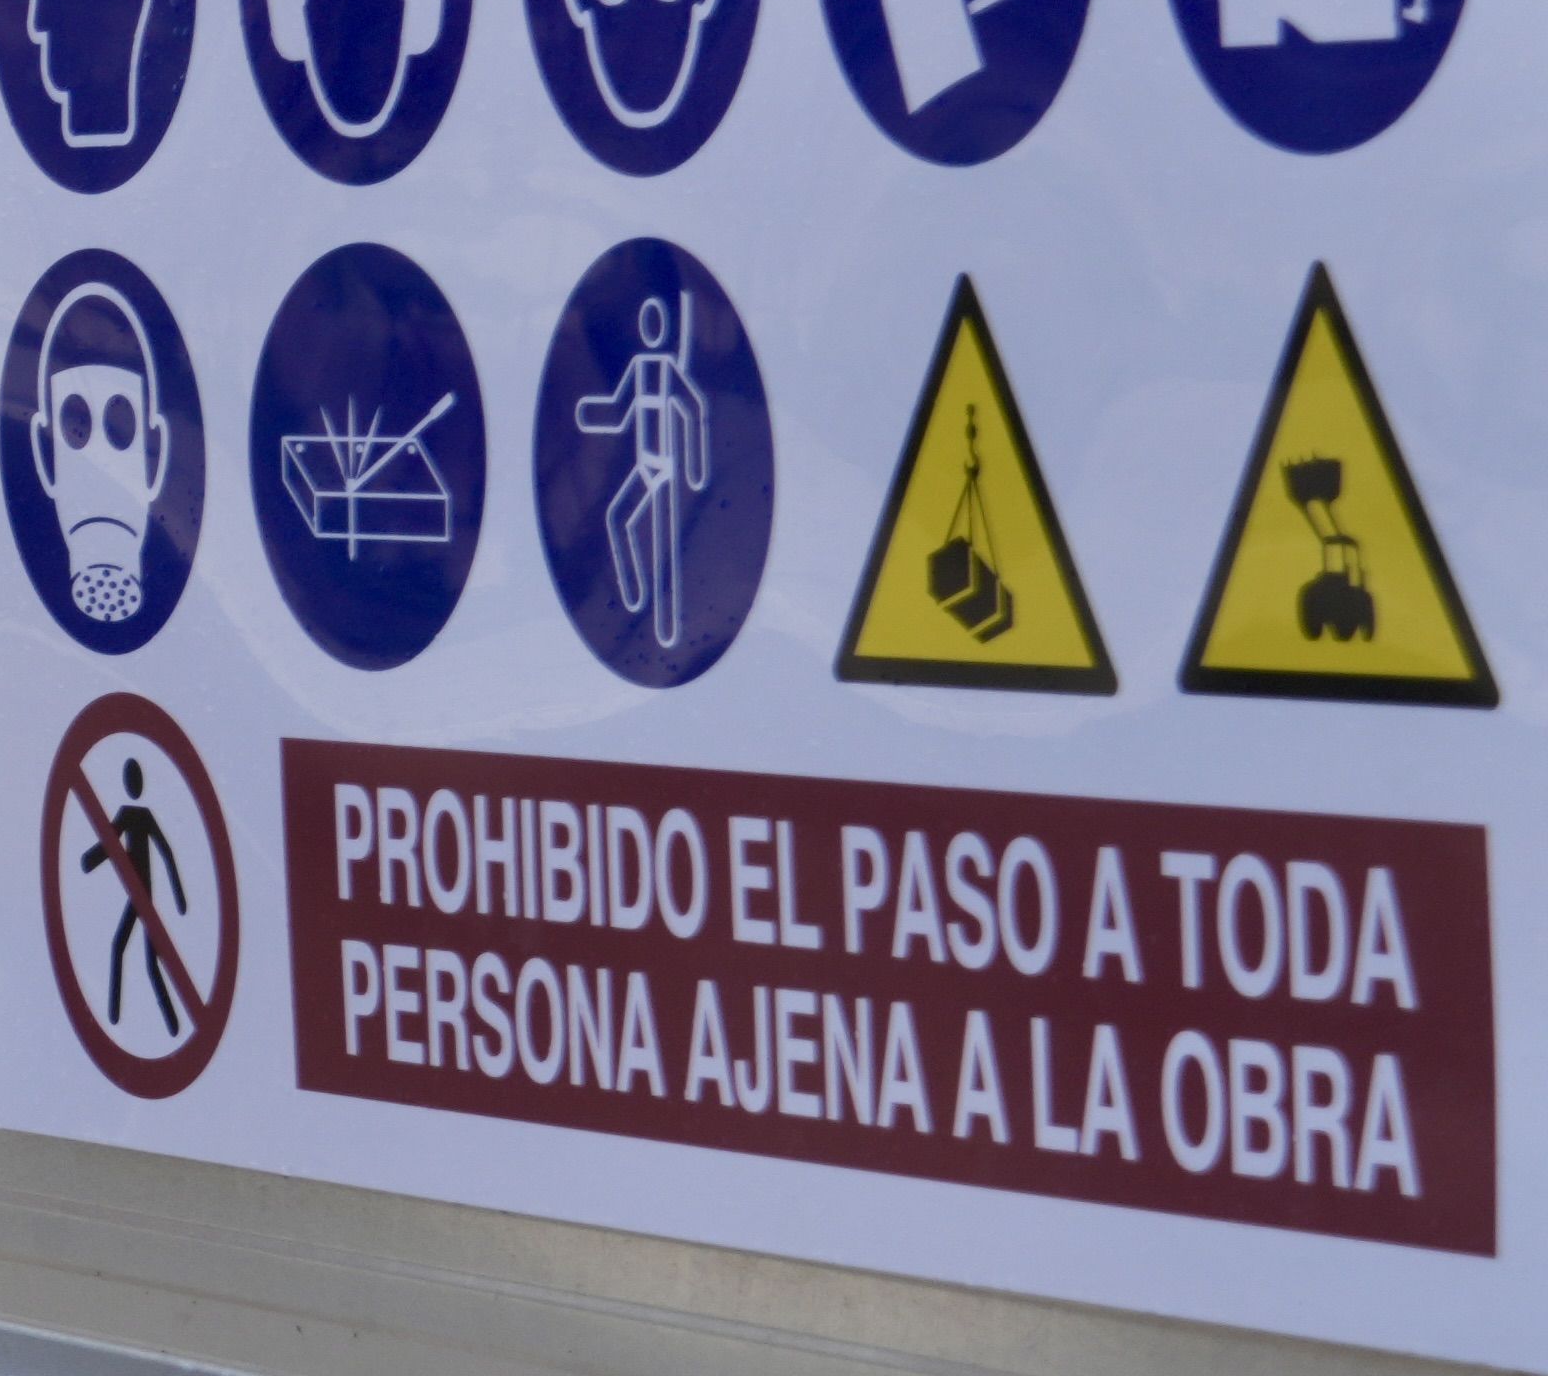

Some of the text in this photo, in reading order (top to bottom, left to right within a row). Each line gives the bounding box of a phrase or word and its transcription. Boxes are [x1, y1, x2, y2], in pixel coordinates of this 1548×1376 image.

[334, 783, 1419, 1012] PROHIBIDO EL PASO A TODA
[341, 938, 1422, 1199] PERSONA AJENA A LA OBRA
